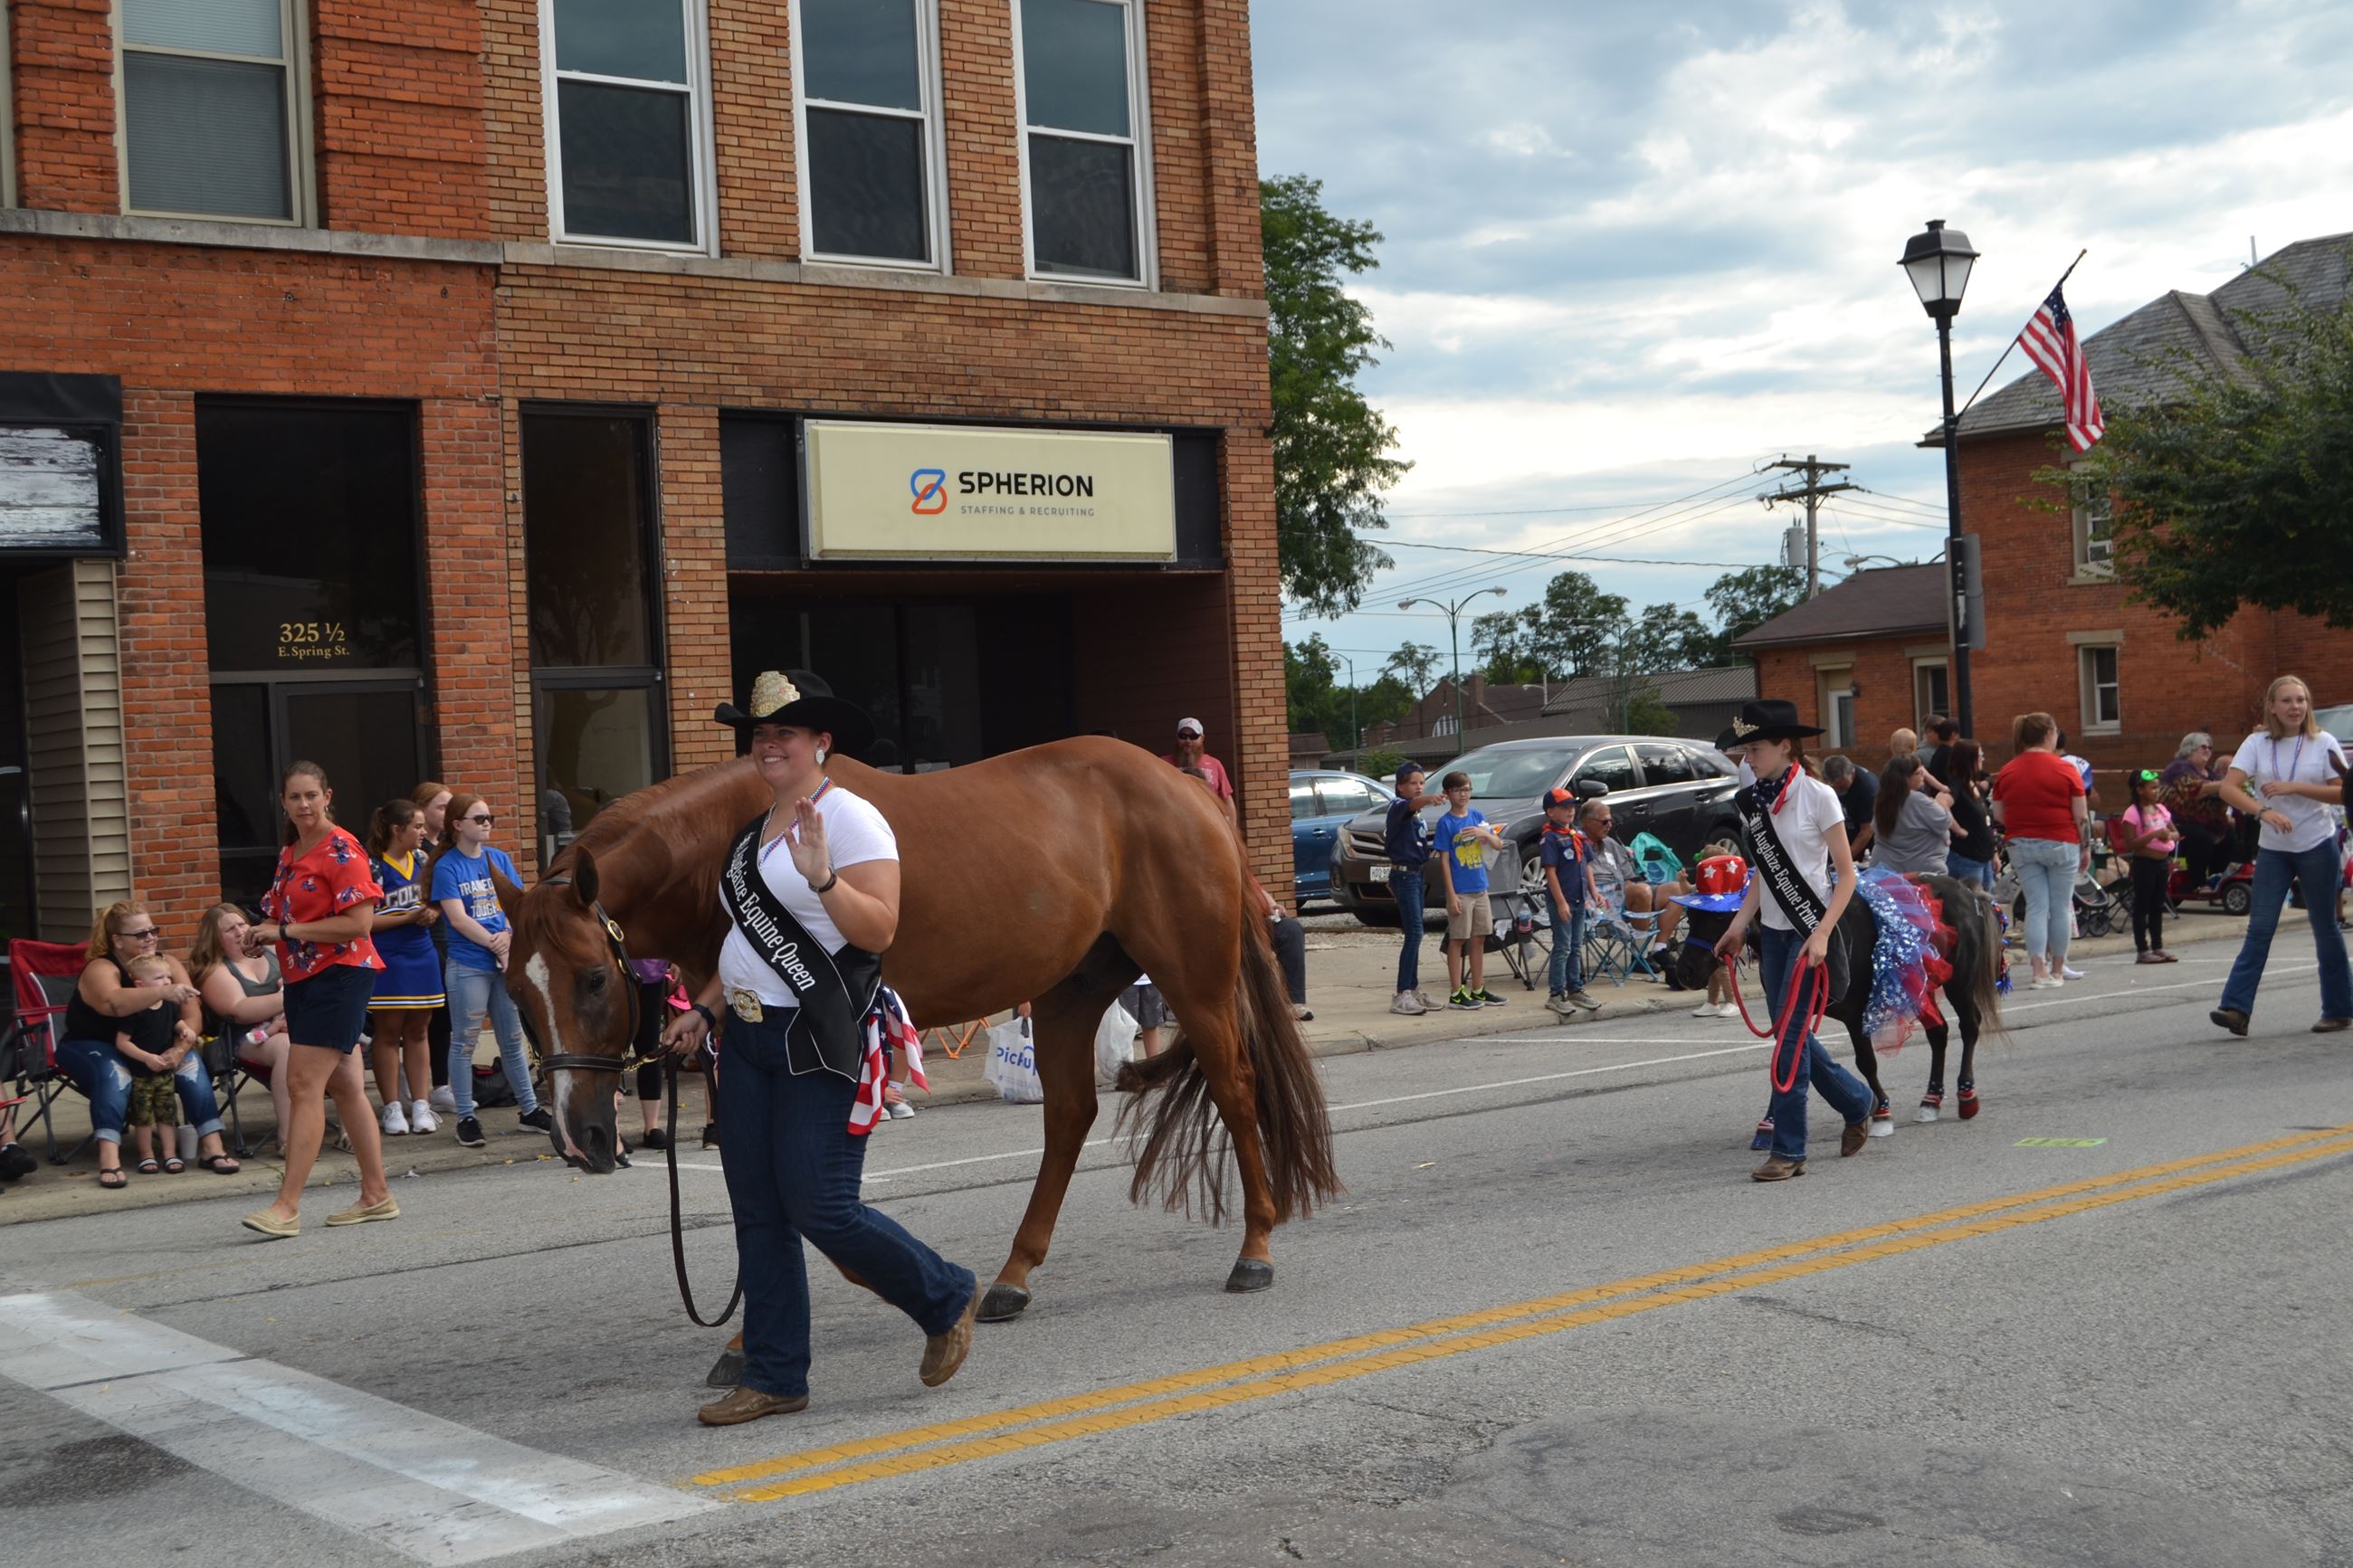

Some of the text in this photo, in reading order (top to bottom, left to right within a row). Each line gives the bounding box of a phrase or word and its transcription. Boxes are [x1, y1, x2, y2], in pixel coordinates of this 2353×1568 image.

[958, 471, 1093, 497] SPHERION
[961, 506, 1095, 517] STAFFING & RECRUITING
[280, 622, 319, 642] 325
[278, 645, 350, 660] E. Spring St.
[1754, 830, 1781, 873] Auglaize
[1775, 869, 1802, 905] Equine
[739, 891, 785, 948] Equine
[771, 942, 816, 992] Queen
